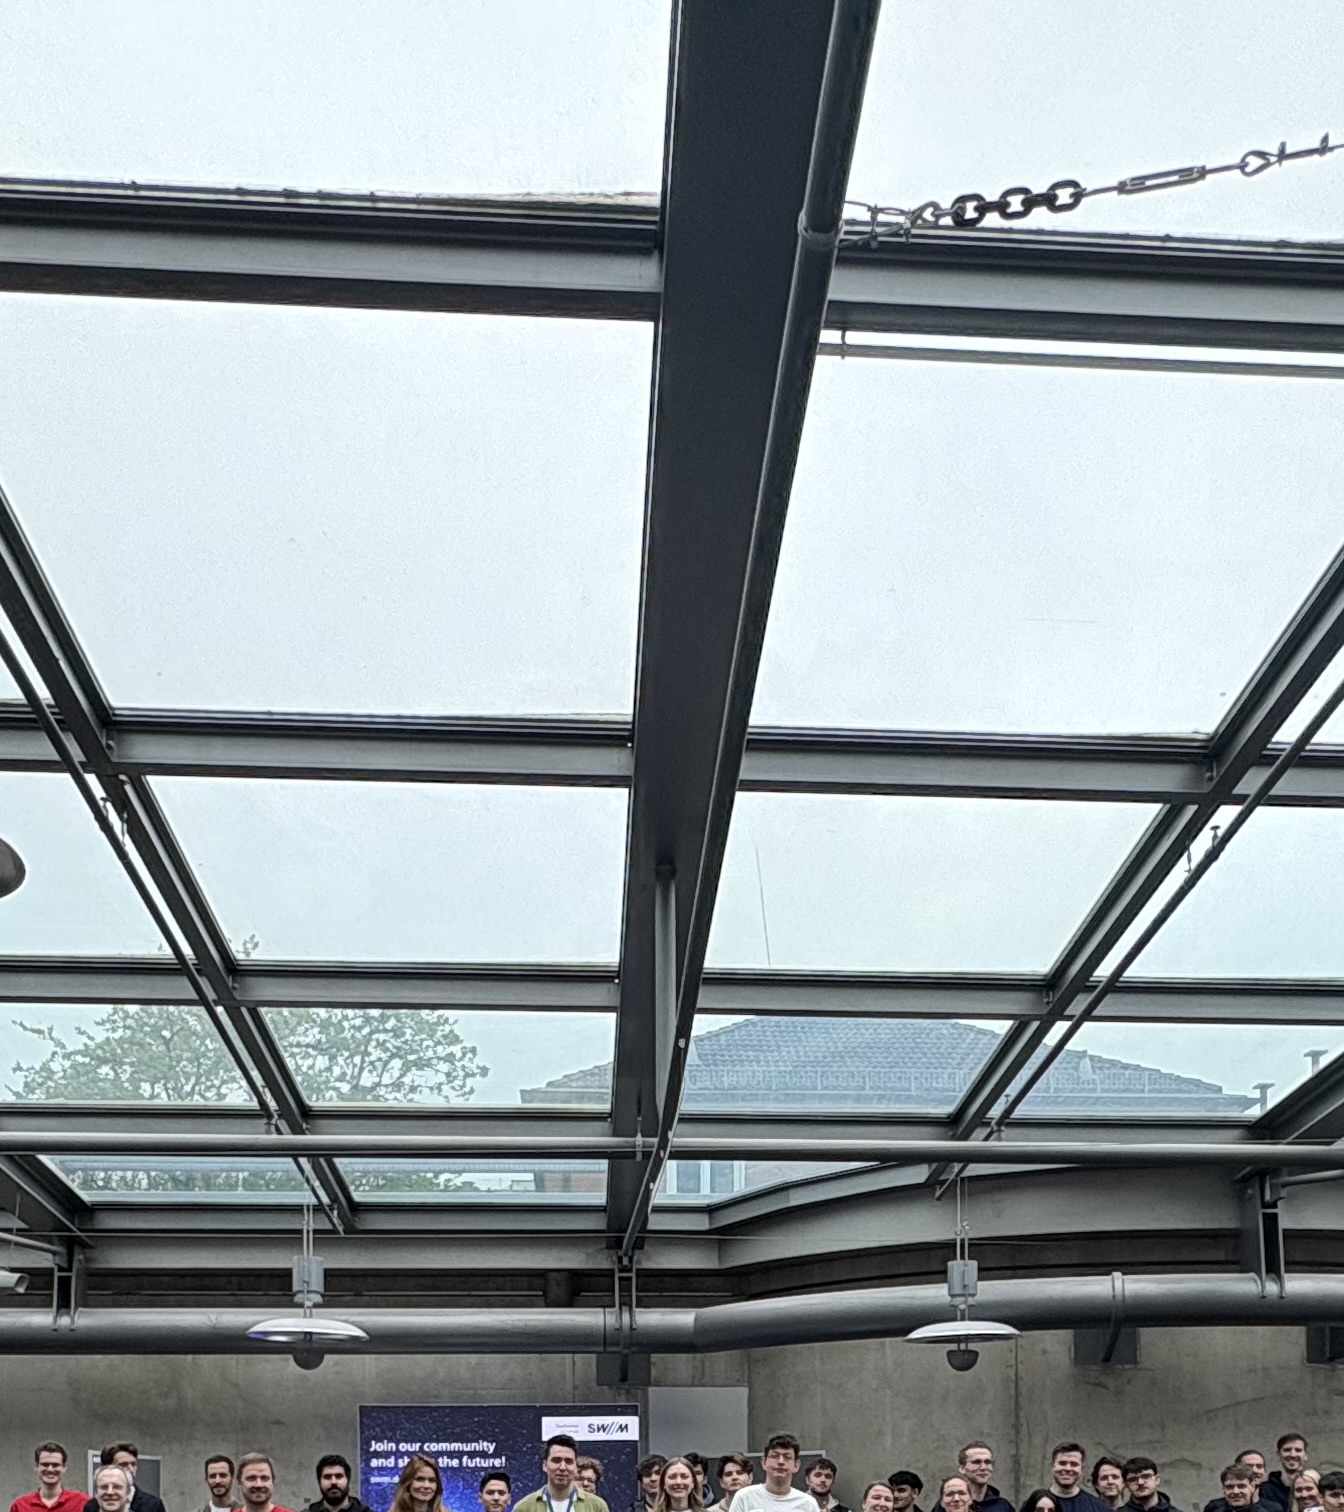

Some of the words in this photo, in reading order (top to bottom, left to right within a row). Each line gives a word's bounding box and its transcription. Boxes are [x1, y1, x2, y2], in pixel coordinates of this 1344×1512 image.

[369, 1440, 396, 1452] Join
[398, 1442, 421, 1452] our
[423, 1440, 496, 1455] community
[370, 1456, 395, 1468] and
[438, 1455, 460, 1468] the
[462, 1455, 506, 1468] future!
